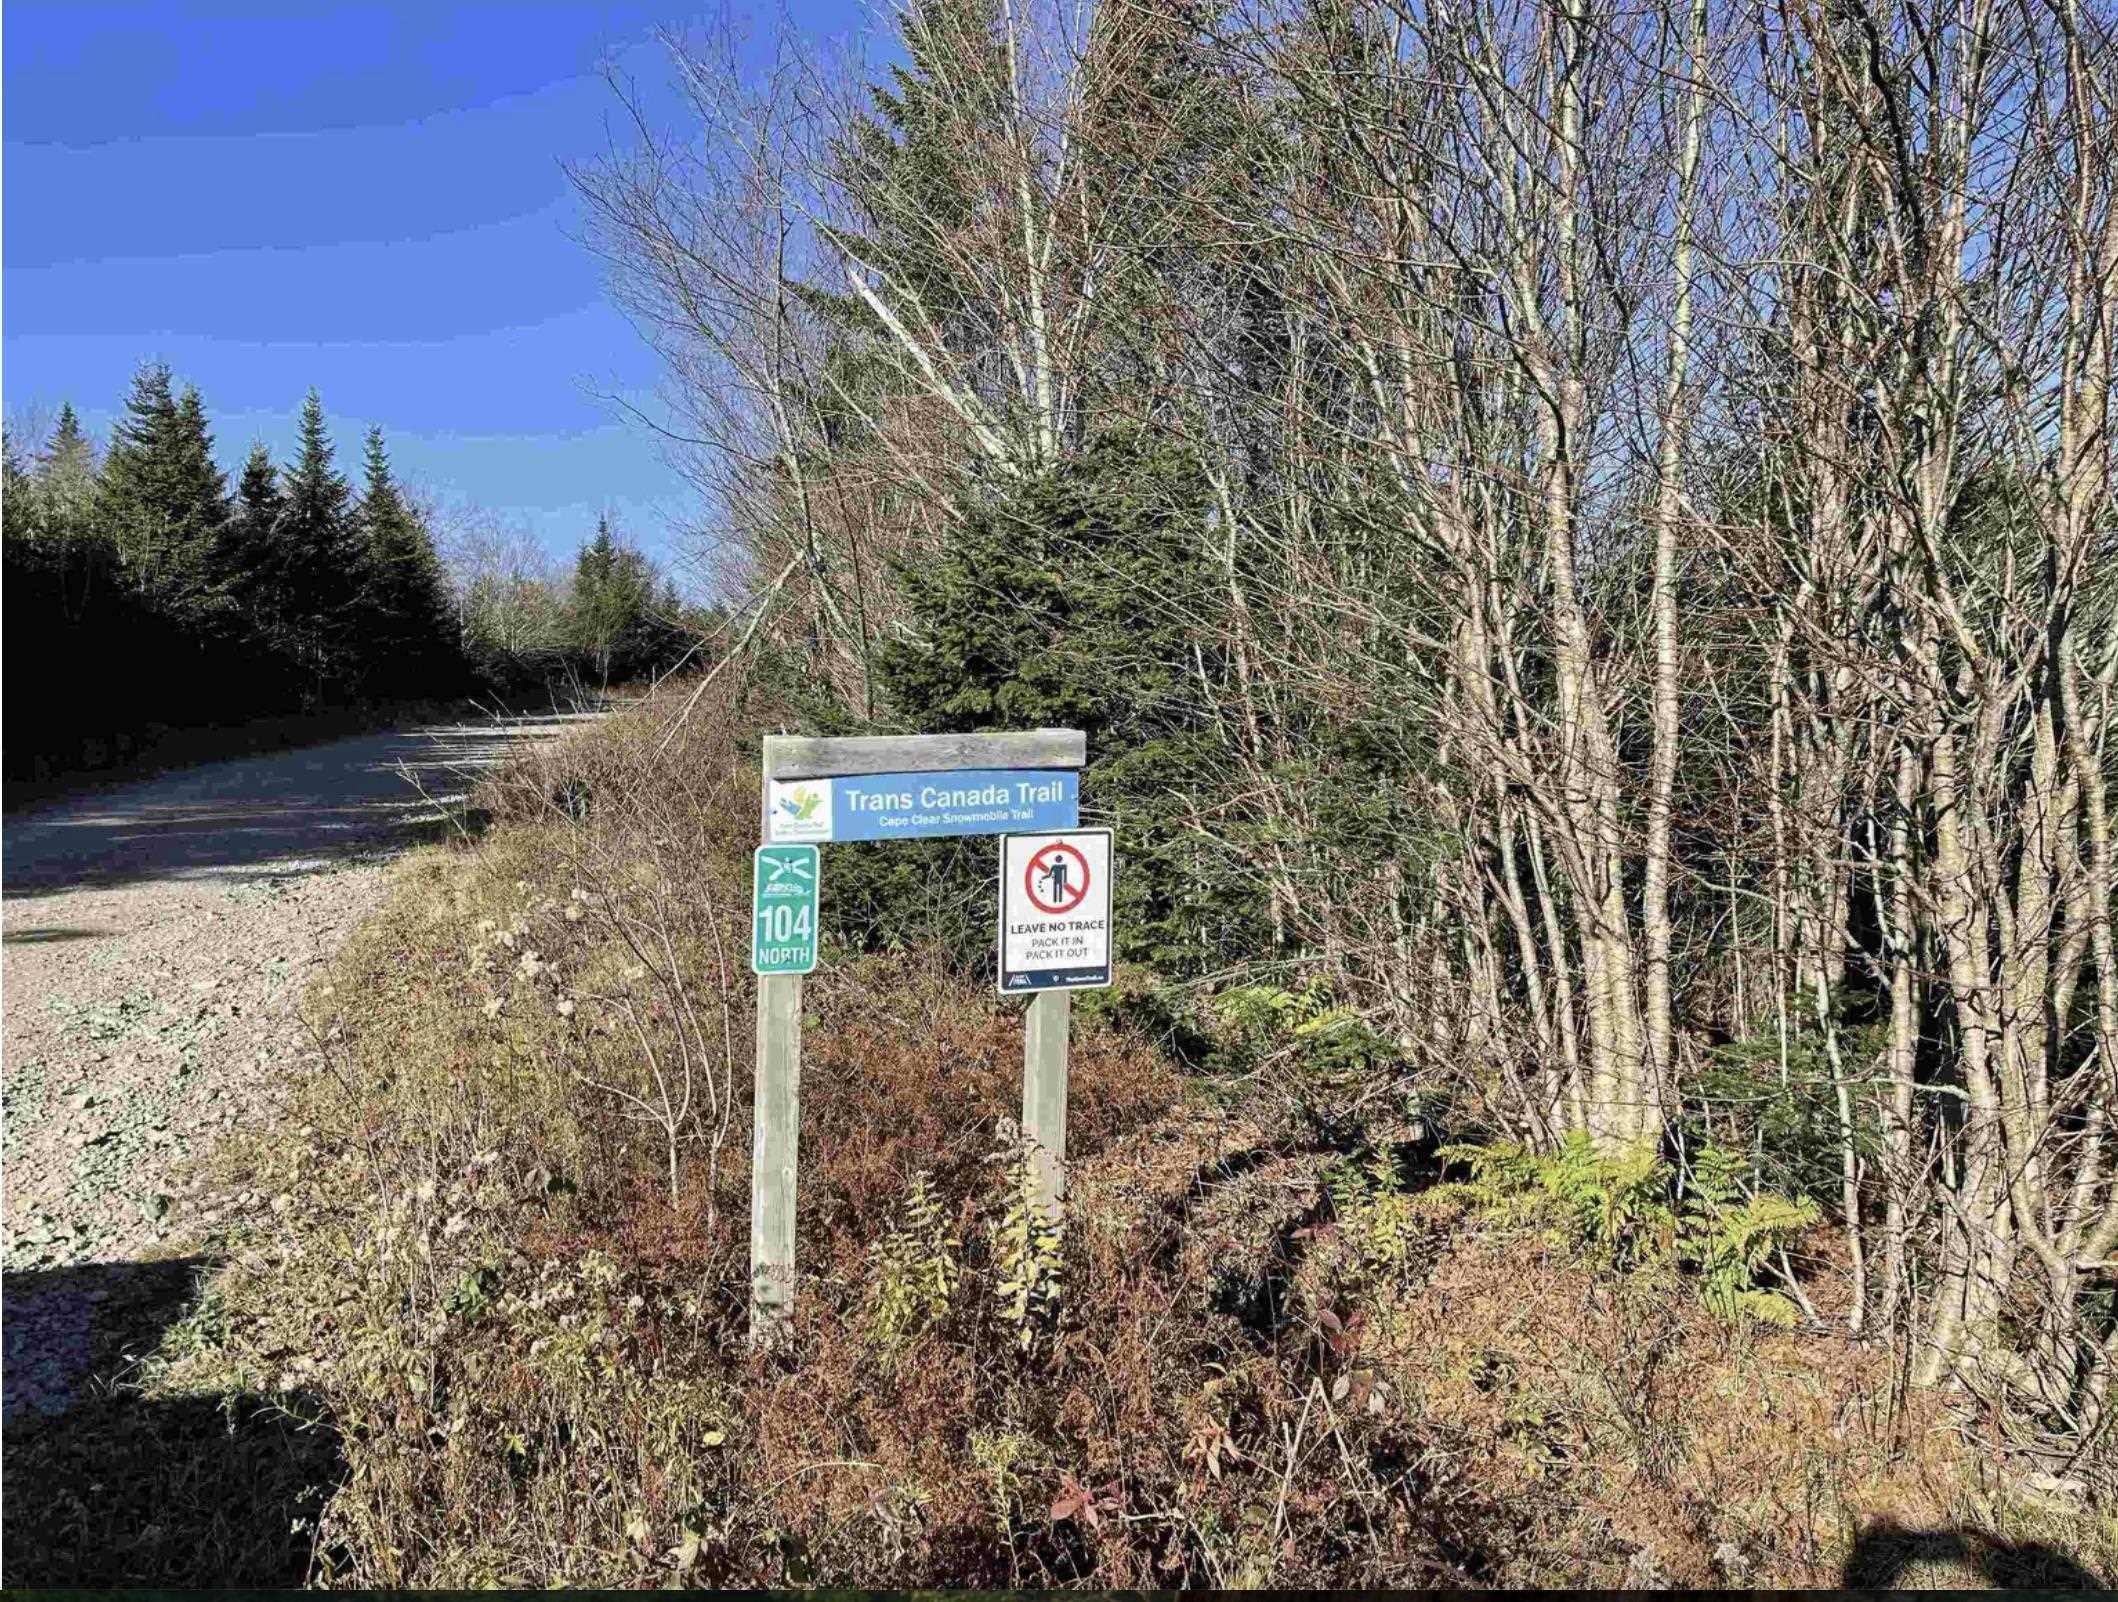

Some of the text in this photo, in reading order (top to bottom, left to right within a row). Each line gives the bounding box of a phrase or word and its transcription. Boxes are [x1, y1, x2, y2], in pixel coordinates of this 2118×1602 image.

[845, 780, 1063, 811] Trans Canada Trail
[879, 806, 1034, 828] Cape Clear Snowmobile Trail
[759, 905, 811, 942] 104
[1011, 920, 1105, 935] LEAVE NO TRACE
[1032, 936, 1083, 948] PACK IT IN
[759, 947, 810, 965] NORTH
[1026, 947, 1088, 961] PACK IT OUT
